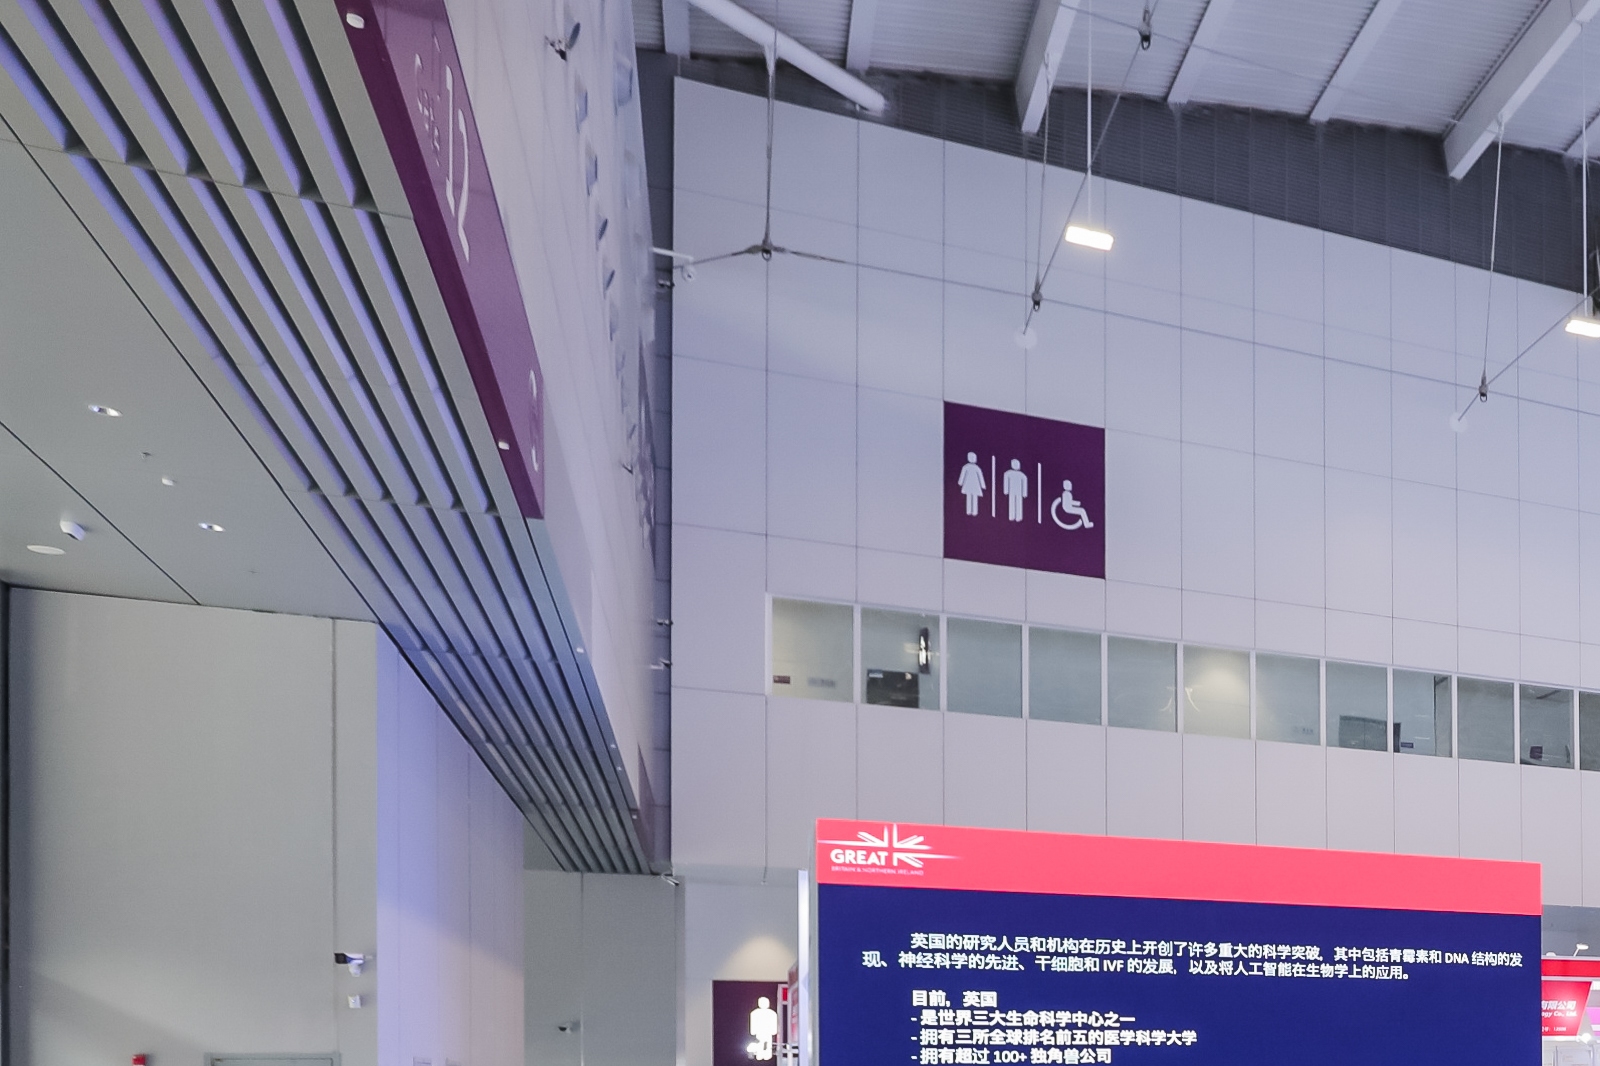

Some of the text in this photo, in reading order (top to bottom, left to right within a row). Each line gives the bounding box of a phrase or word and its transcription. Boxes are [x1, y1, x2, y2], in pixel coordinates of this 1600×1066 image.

[830, 848, 889, 866] GREAT
[831, 865, 856, 873] BRITAIN
[862, 867, 897, 875] NORTHERN
[1103, 959, 1125, 973] IVF
[1445, 951, 1470, 965] DNA
[1472, 951, 1524, 968] 结构的发
[993, 1050, 1028, 1064] 100+
